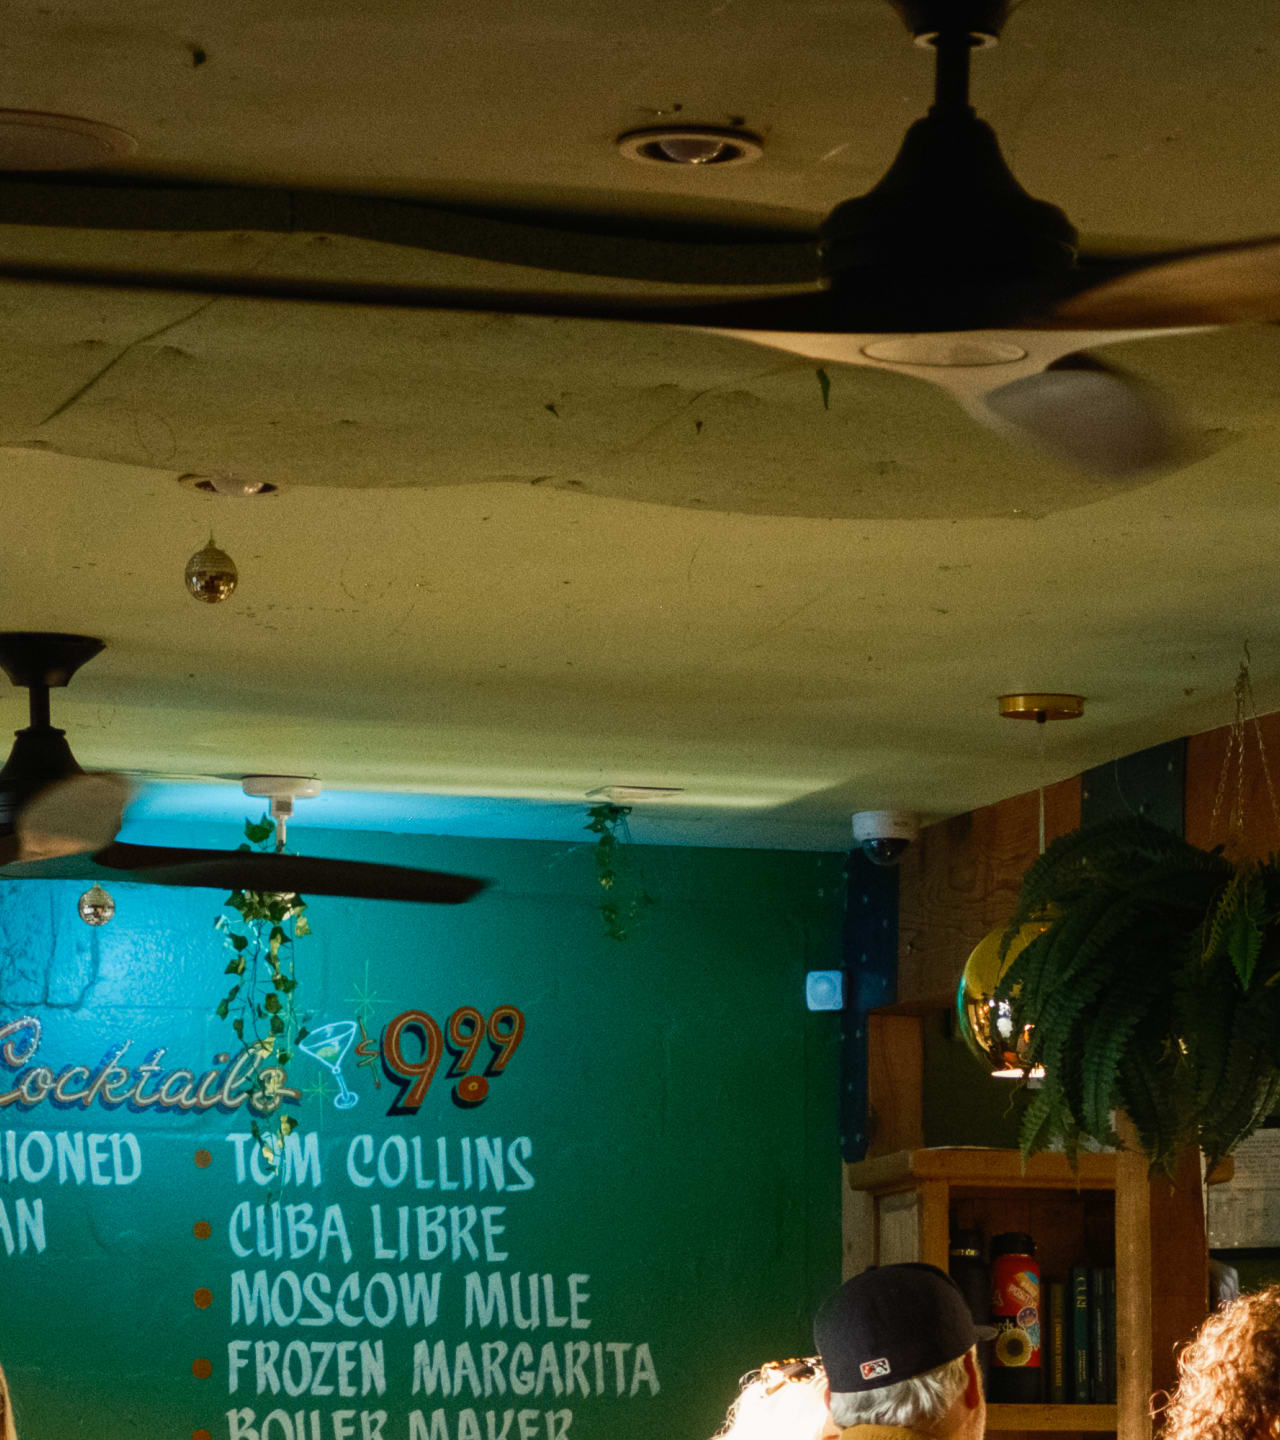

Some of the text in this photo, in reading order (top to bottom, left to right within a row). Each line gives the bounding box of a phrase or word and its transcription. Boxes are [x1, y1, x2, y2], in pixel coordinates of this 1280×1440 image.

[224, 1130, 536, 1194] TOM COLLINS
[228, 1202, 509, 1263] CUBA LIBRE
[230, 1269, 592, 1331] MOSCOW MULE
[227, 1338, 661, 1399] FROZEN MARGARITA
